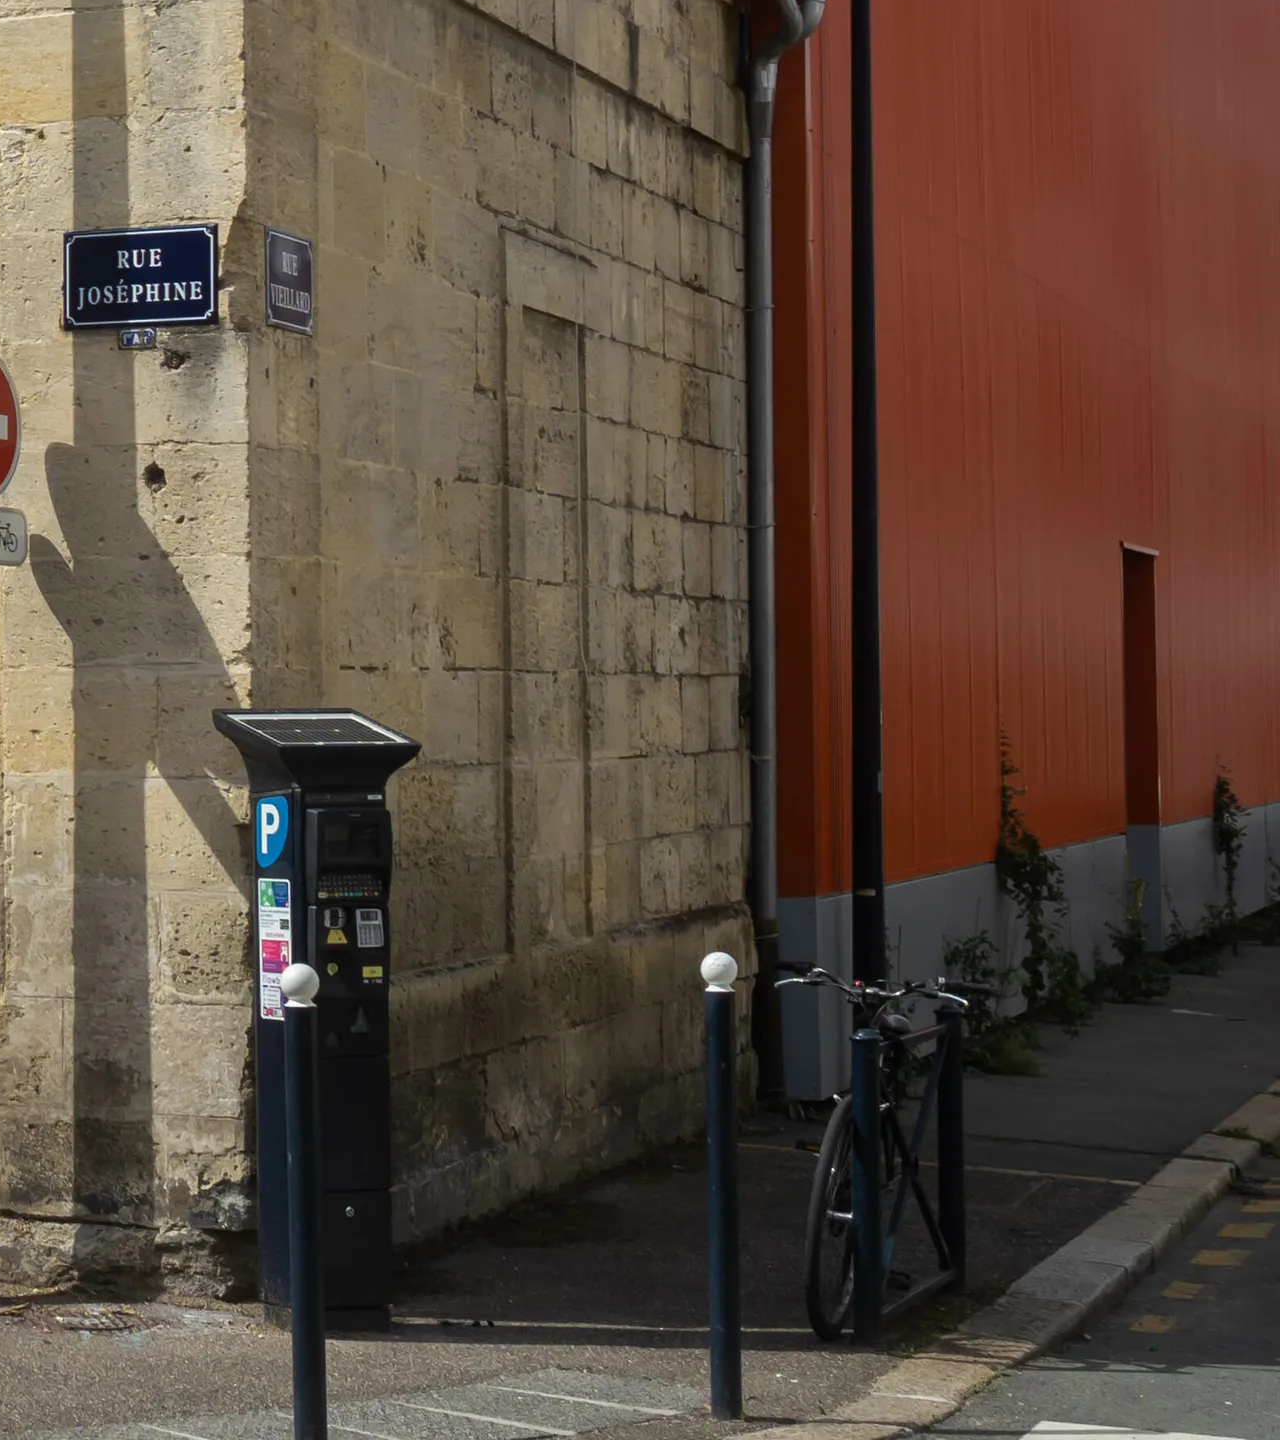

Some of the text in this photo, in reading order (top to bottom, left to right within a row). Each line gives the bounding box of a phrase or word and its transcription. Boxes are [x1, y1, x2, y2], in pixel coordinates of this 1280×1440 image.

[117, 248, 162, 269] RUE
[282, 251, 298, 276] RUE
[77, 279, 203, 310] JOSÉPHINE
[270, 283, 310, 314] VIEILLARD
[261, 803, 280, 854] P
